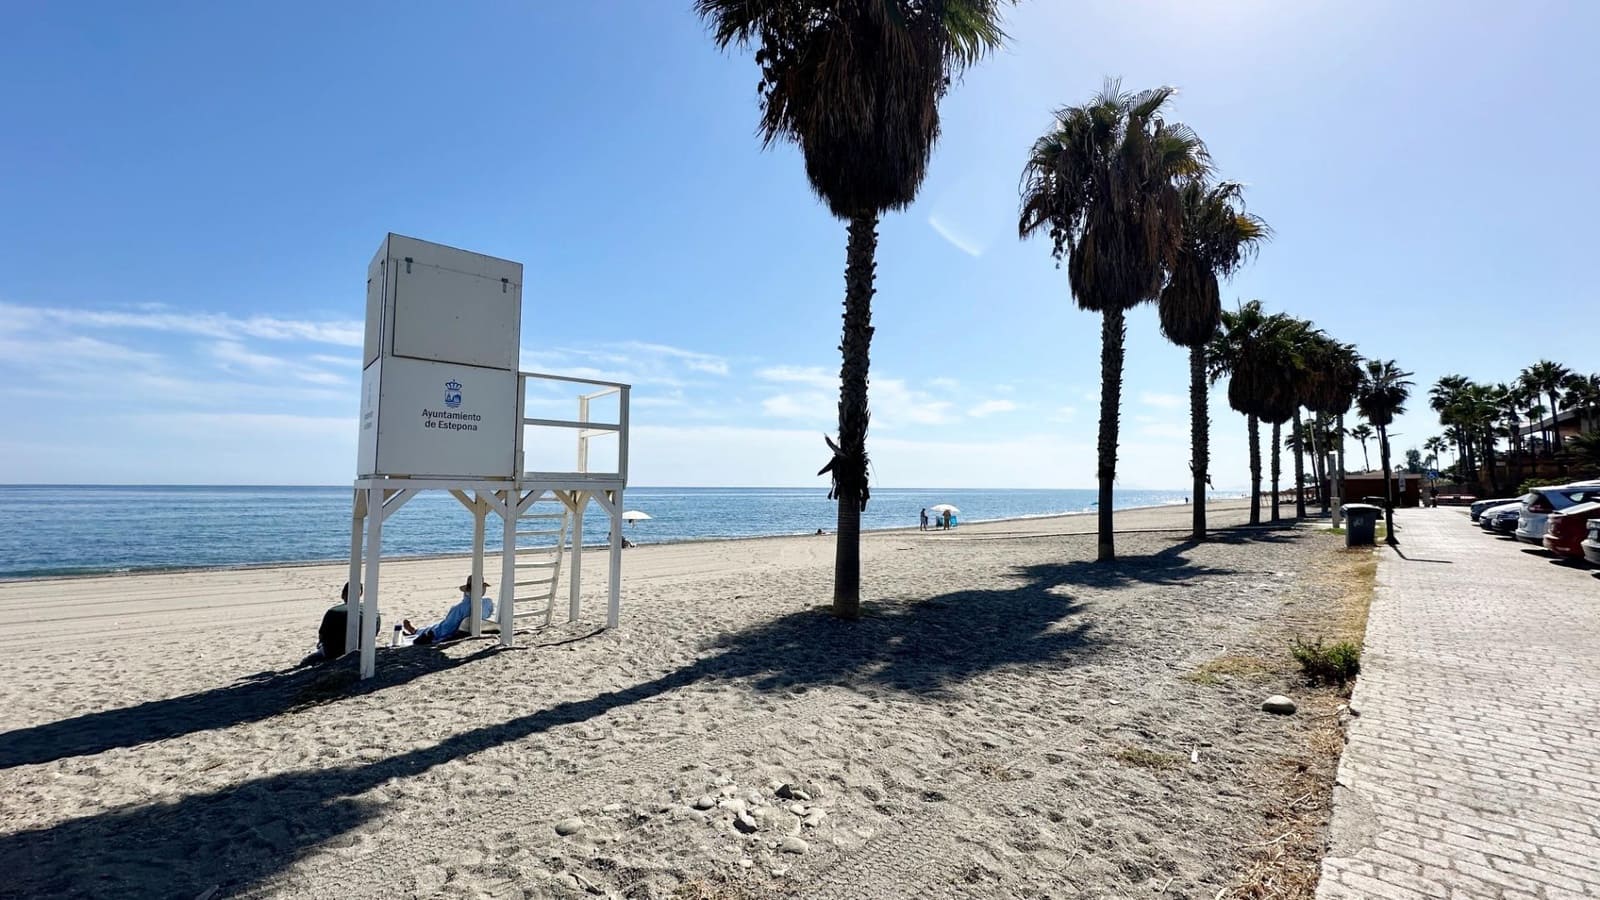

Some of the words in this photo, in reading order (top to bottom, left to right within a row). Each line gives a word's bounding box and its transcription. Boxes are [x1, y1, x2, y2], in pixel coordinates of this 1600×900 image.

[422, 409, 481, 421] Ayuntamiento
[425, 420, 436, 428] de
[438, 421, 478, 431] Estepona
